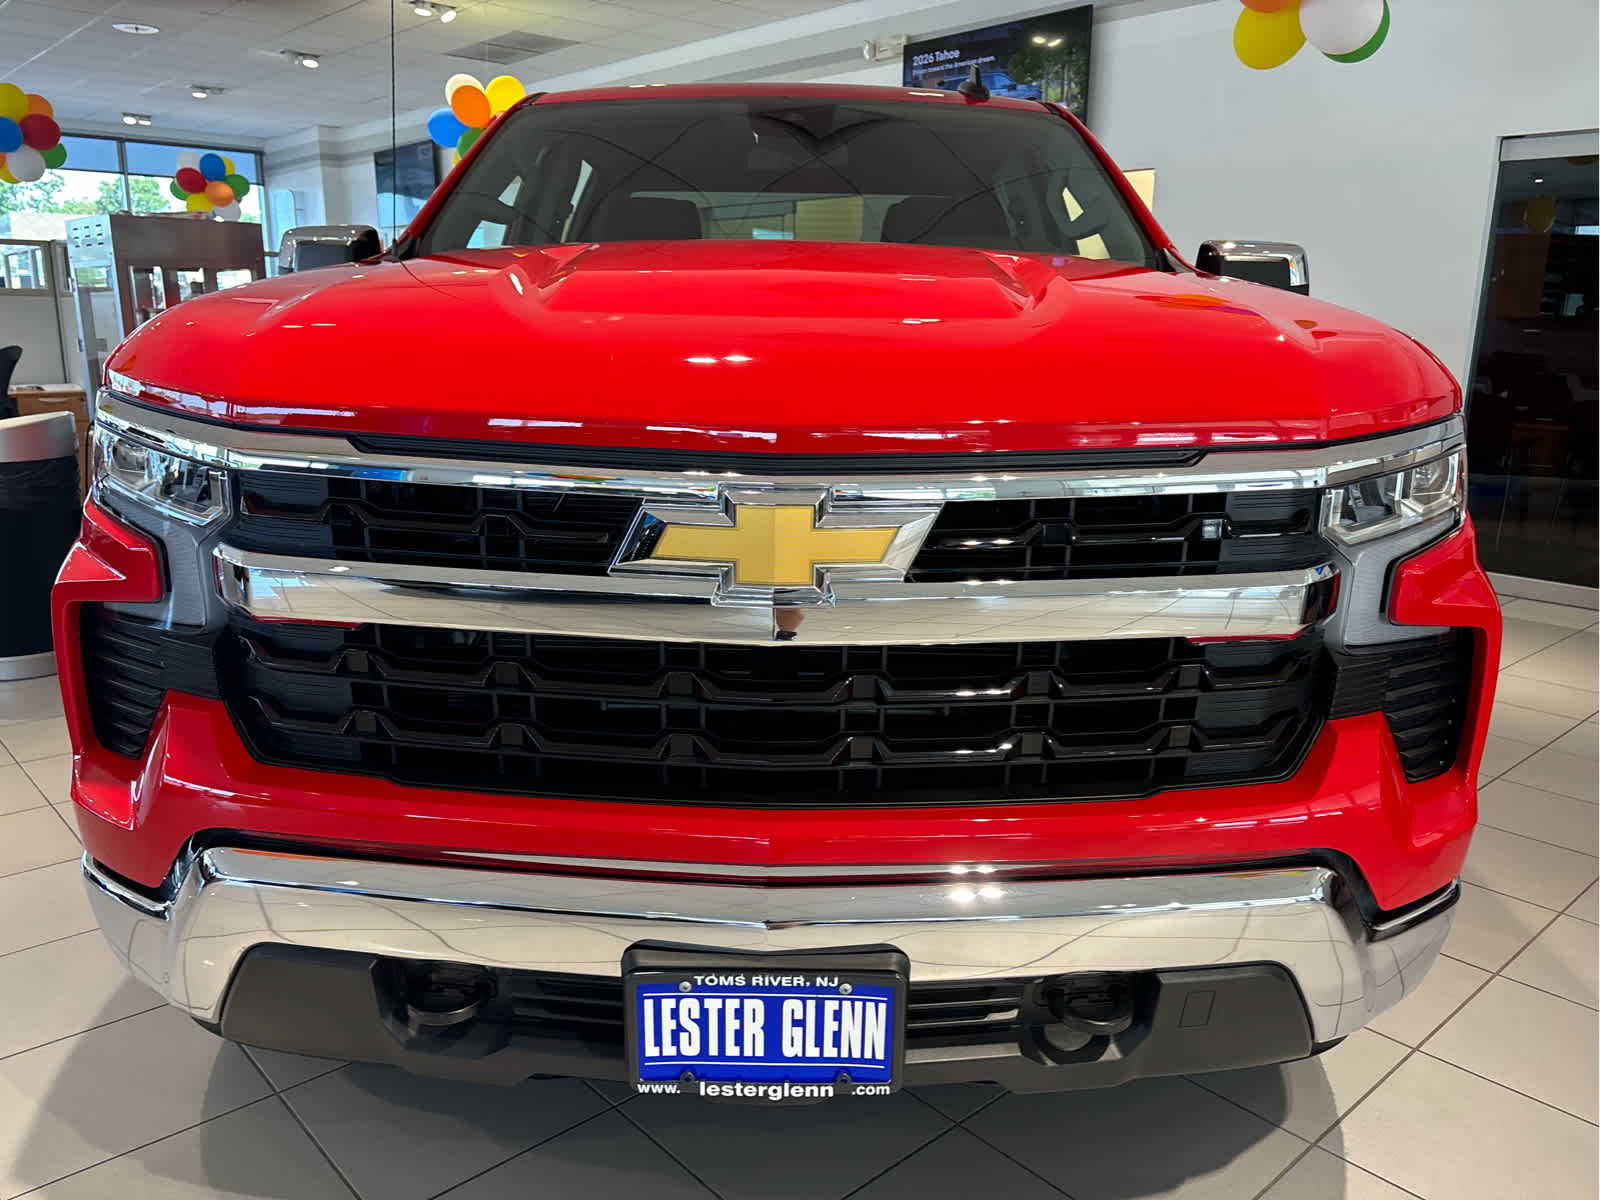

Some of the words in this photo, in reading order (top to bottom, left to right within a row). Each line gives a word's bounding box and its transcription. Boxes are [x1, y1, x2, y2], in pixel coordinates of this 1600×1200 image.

[912, 53, 934, 66] 2026
[935, 49, 960, 61] Tahoe
[693, 975, 746, 986] TOMS
[752, 976, 810, 987] RIVER,
[816, 977, 839, 987] NJ
[643, 998, 765, 1057] LESTER
[782, 998, 887, 1060] GLENN
[637, 1083, 681, 1094] www.
[699, 1081, 834, 1100] lesterglenn
[851, 1085, 890, 1096] .com
